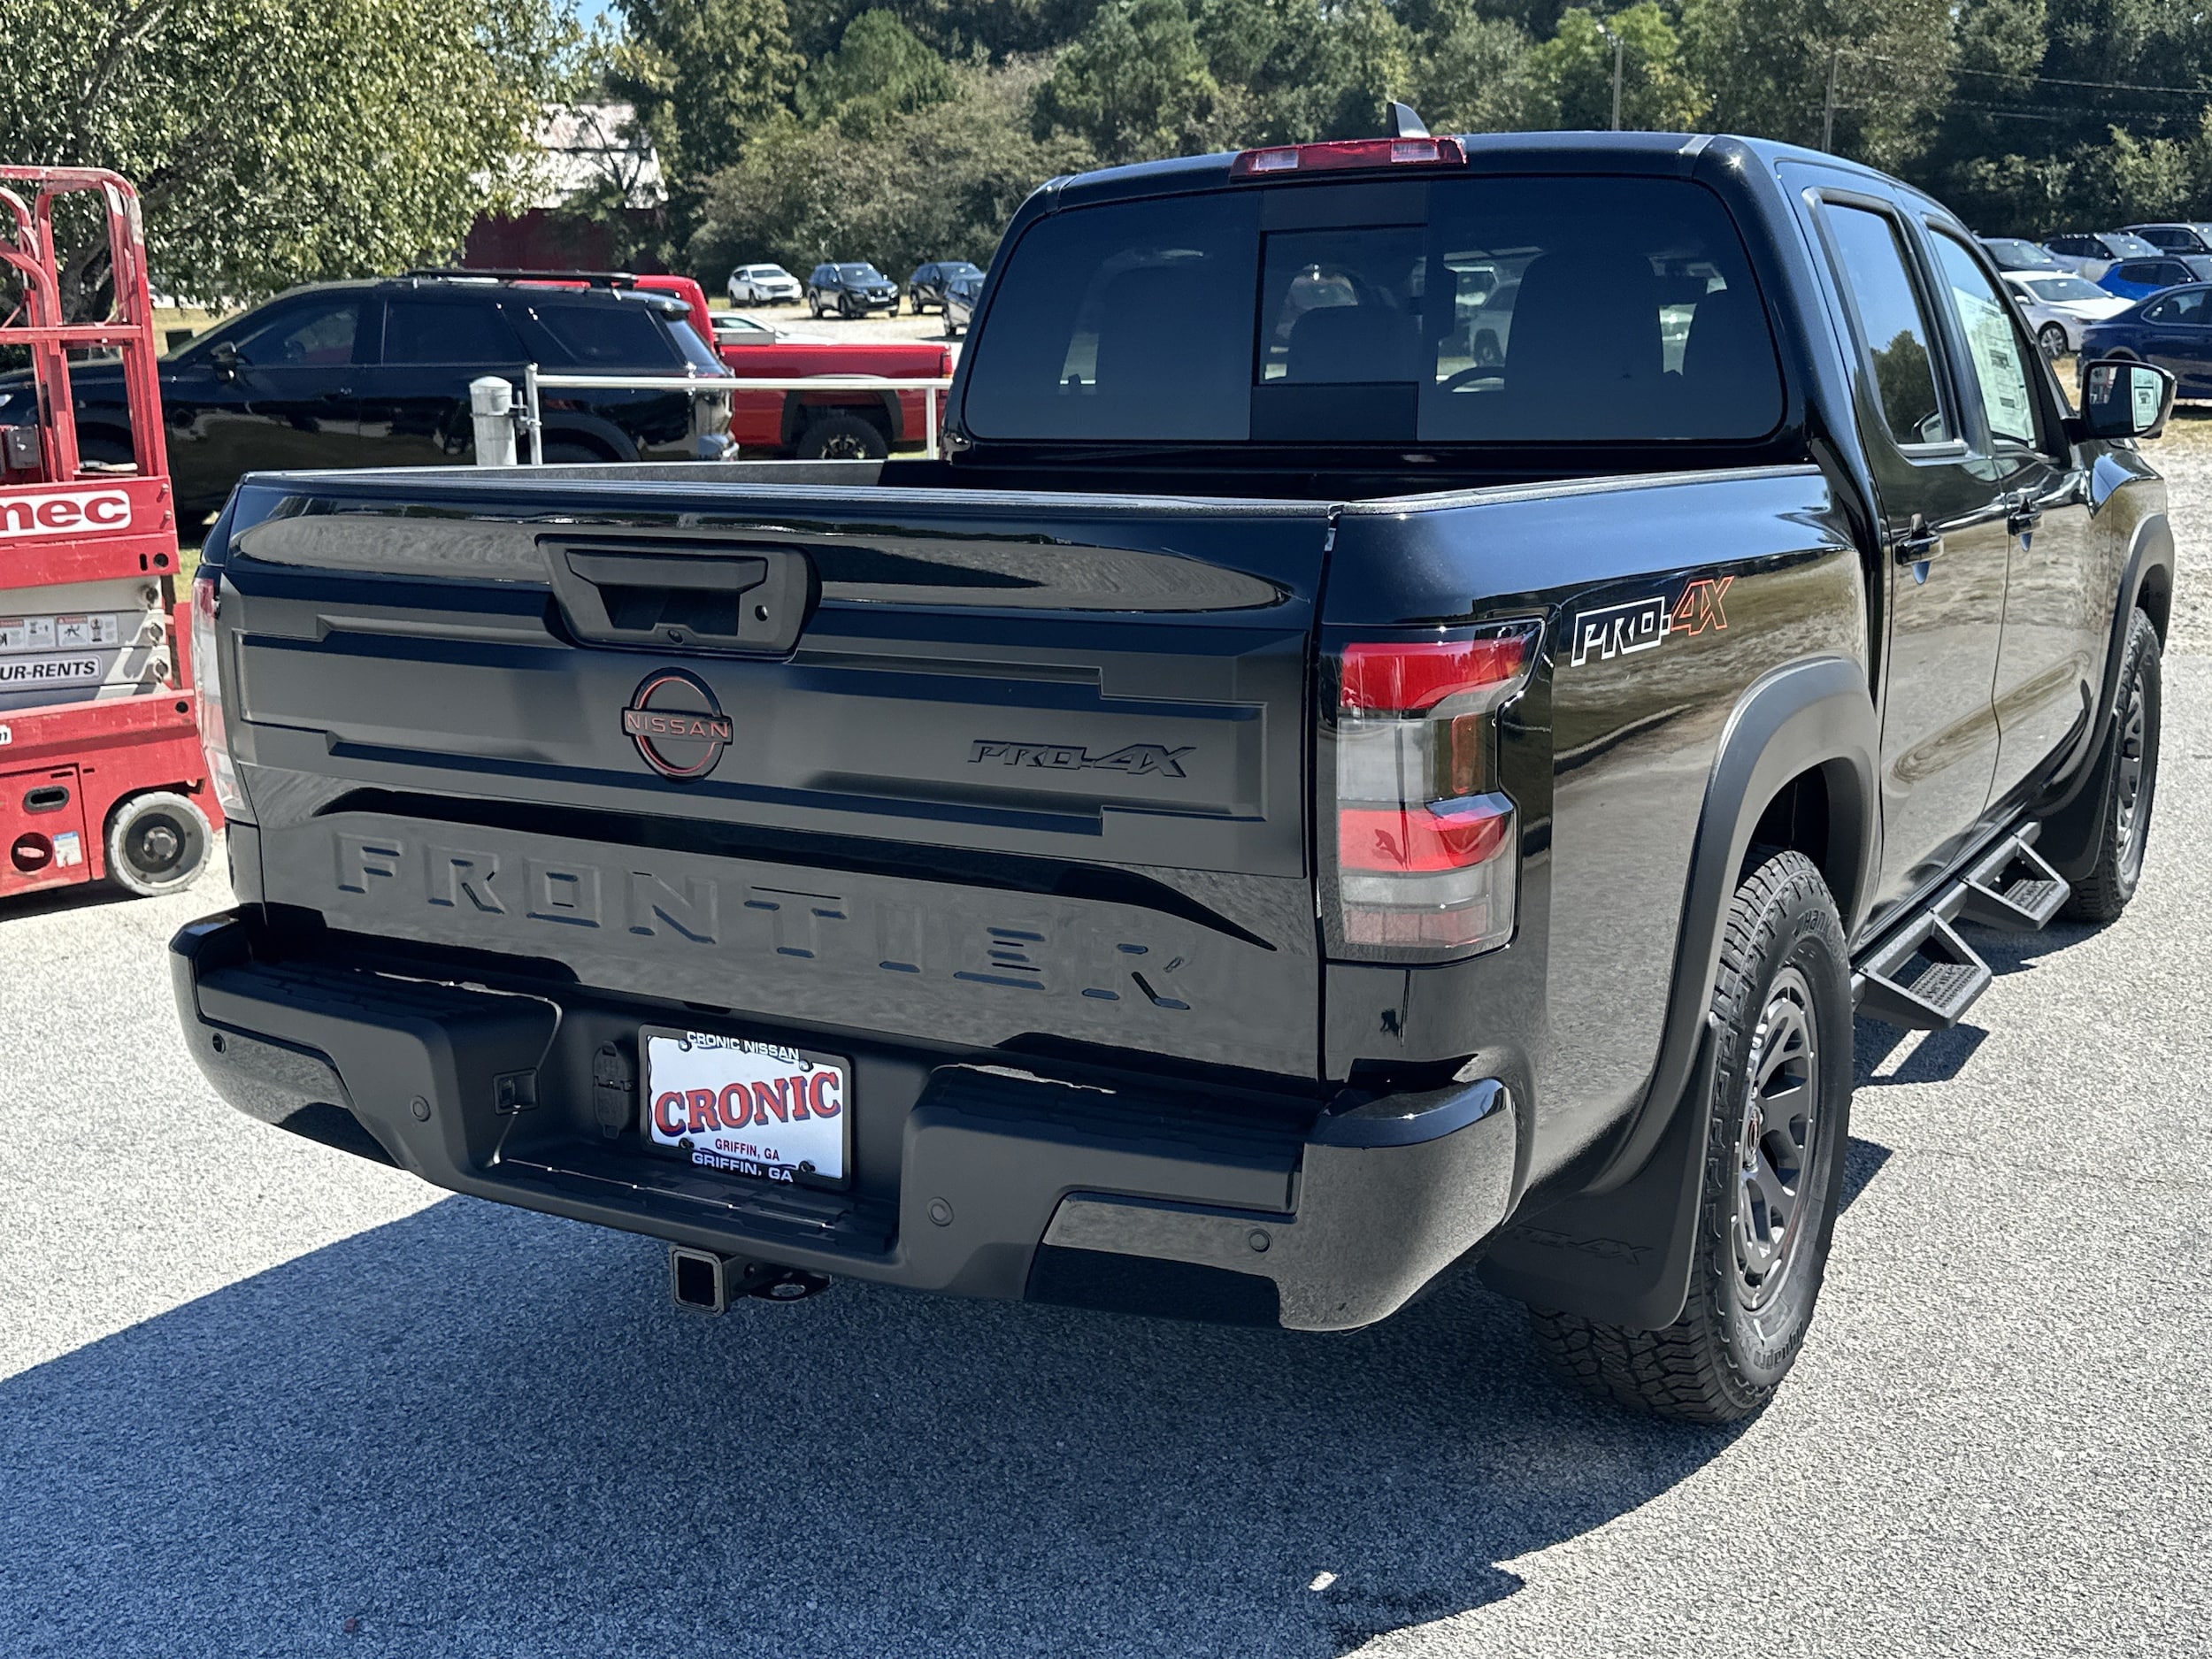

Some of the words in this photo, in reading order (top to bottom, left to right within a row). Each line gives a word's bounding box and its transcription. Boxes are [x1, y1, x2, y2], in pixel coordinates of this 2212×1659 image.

[625, 712, 730, 740] NISSAN
[333, 831, 1192, 1010] FRONTIER
[687, 1031, 741, 1051] CRONIC
[743, 1040, 799, 1060] NISSAN
[655, 1071, 841, 1137] CRONIC
[715, 1139, 761, 1160] GRIFFIN,
[764, 1148, 780, 1161] GA
[692, 1152, 762, 1177] GRIFFIN,
[768, 1167, 793, 1183] GA
